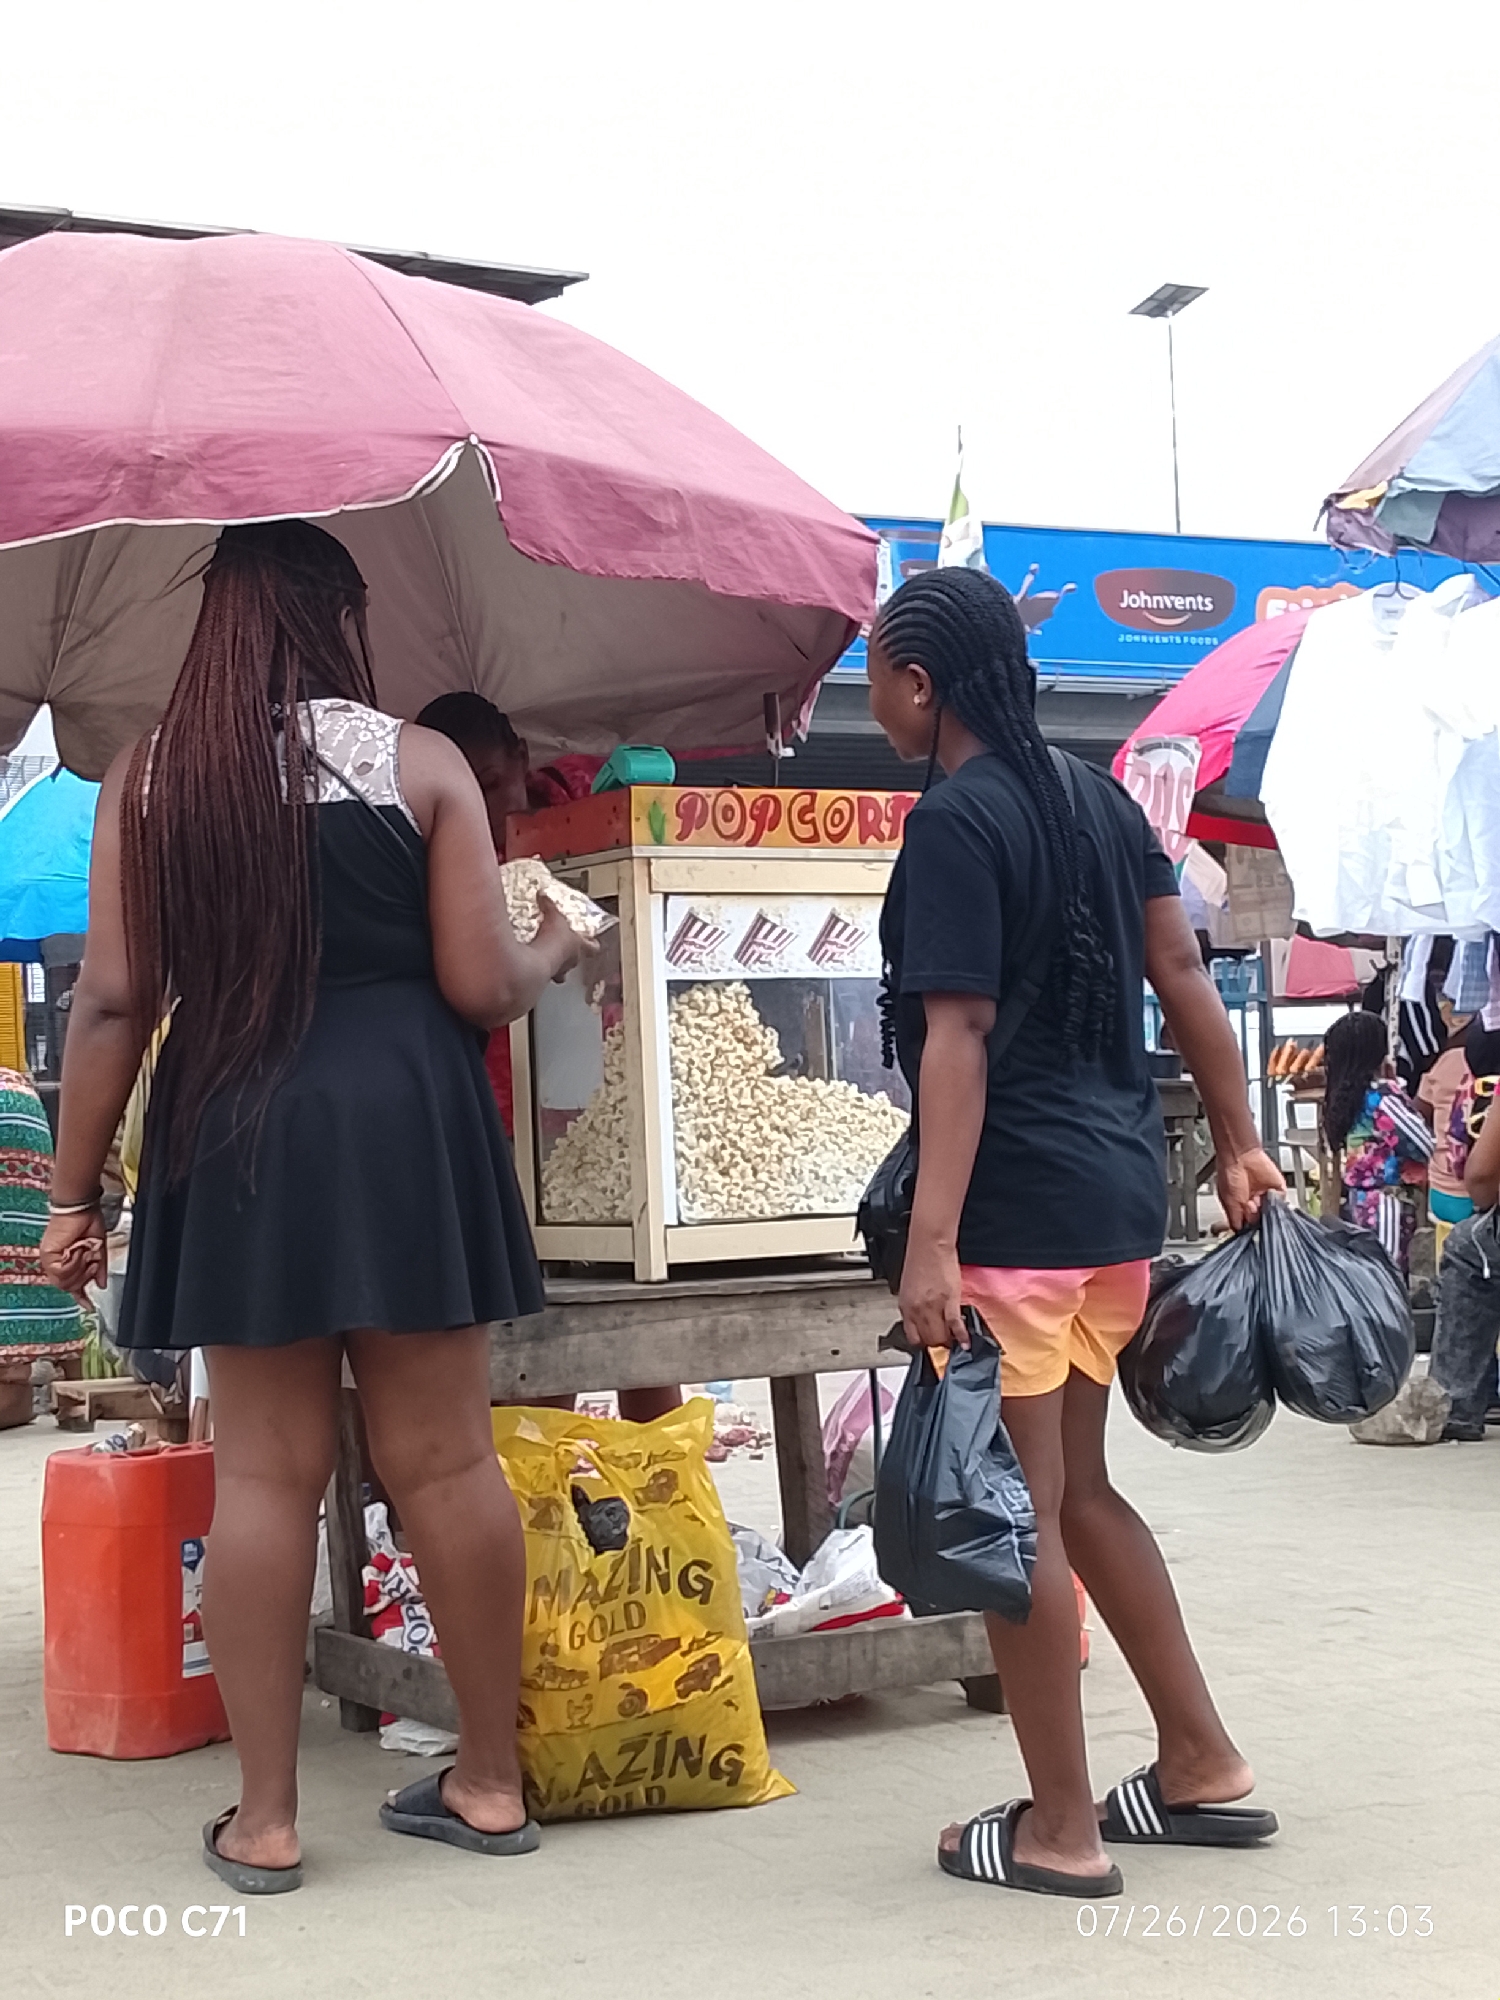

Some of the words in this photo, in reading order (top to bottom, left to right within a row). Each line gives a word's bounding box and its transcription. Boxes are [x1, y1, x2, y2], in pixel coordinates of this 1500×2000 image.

[1118, 589, 1214, 612] Johnvents
[569, 1600, 646, 1651] GOLD
[574, 1785, 667, 1816] GOLD
